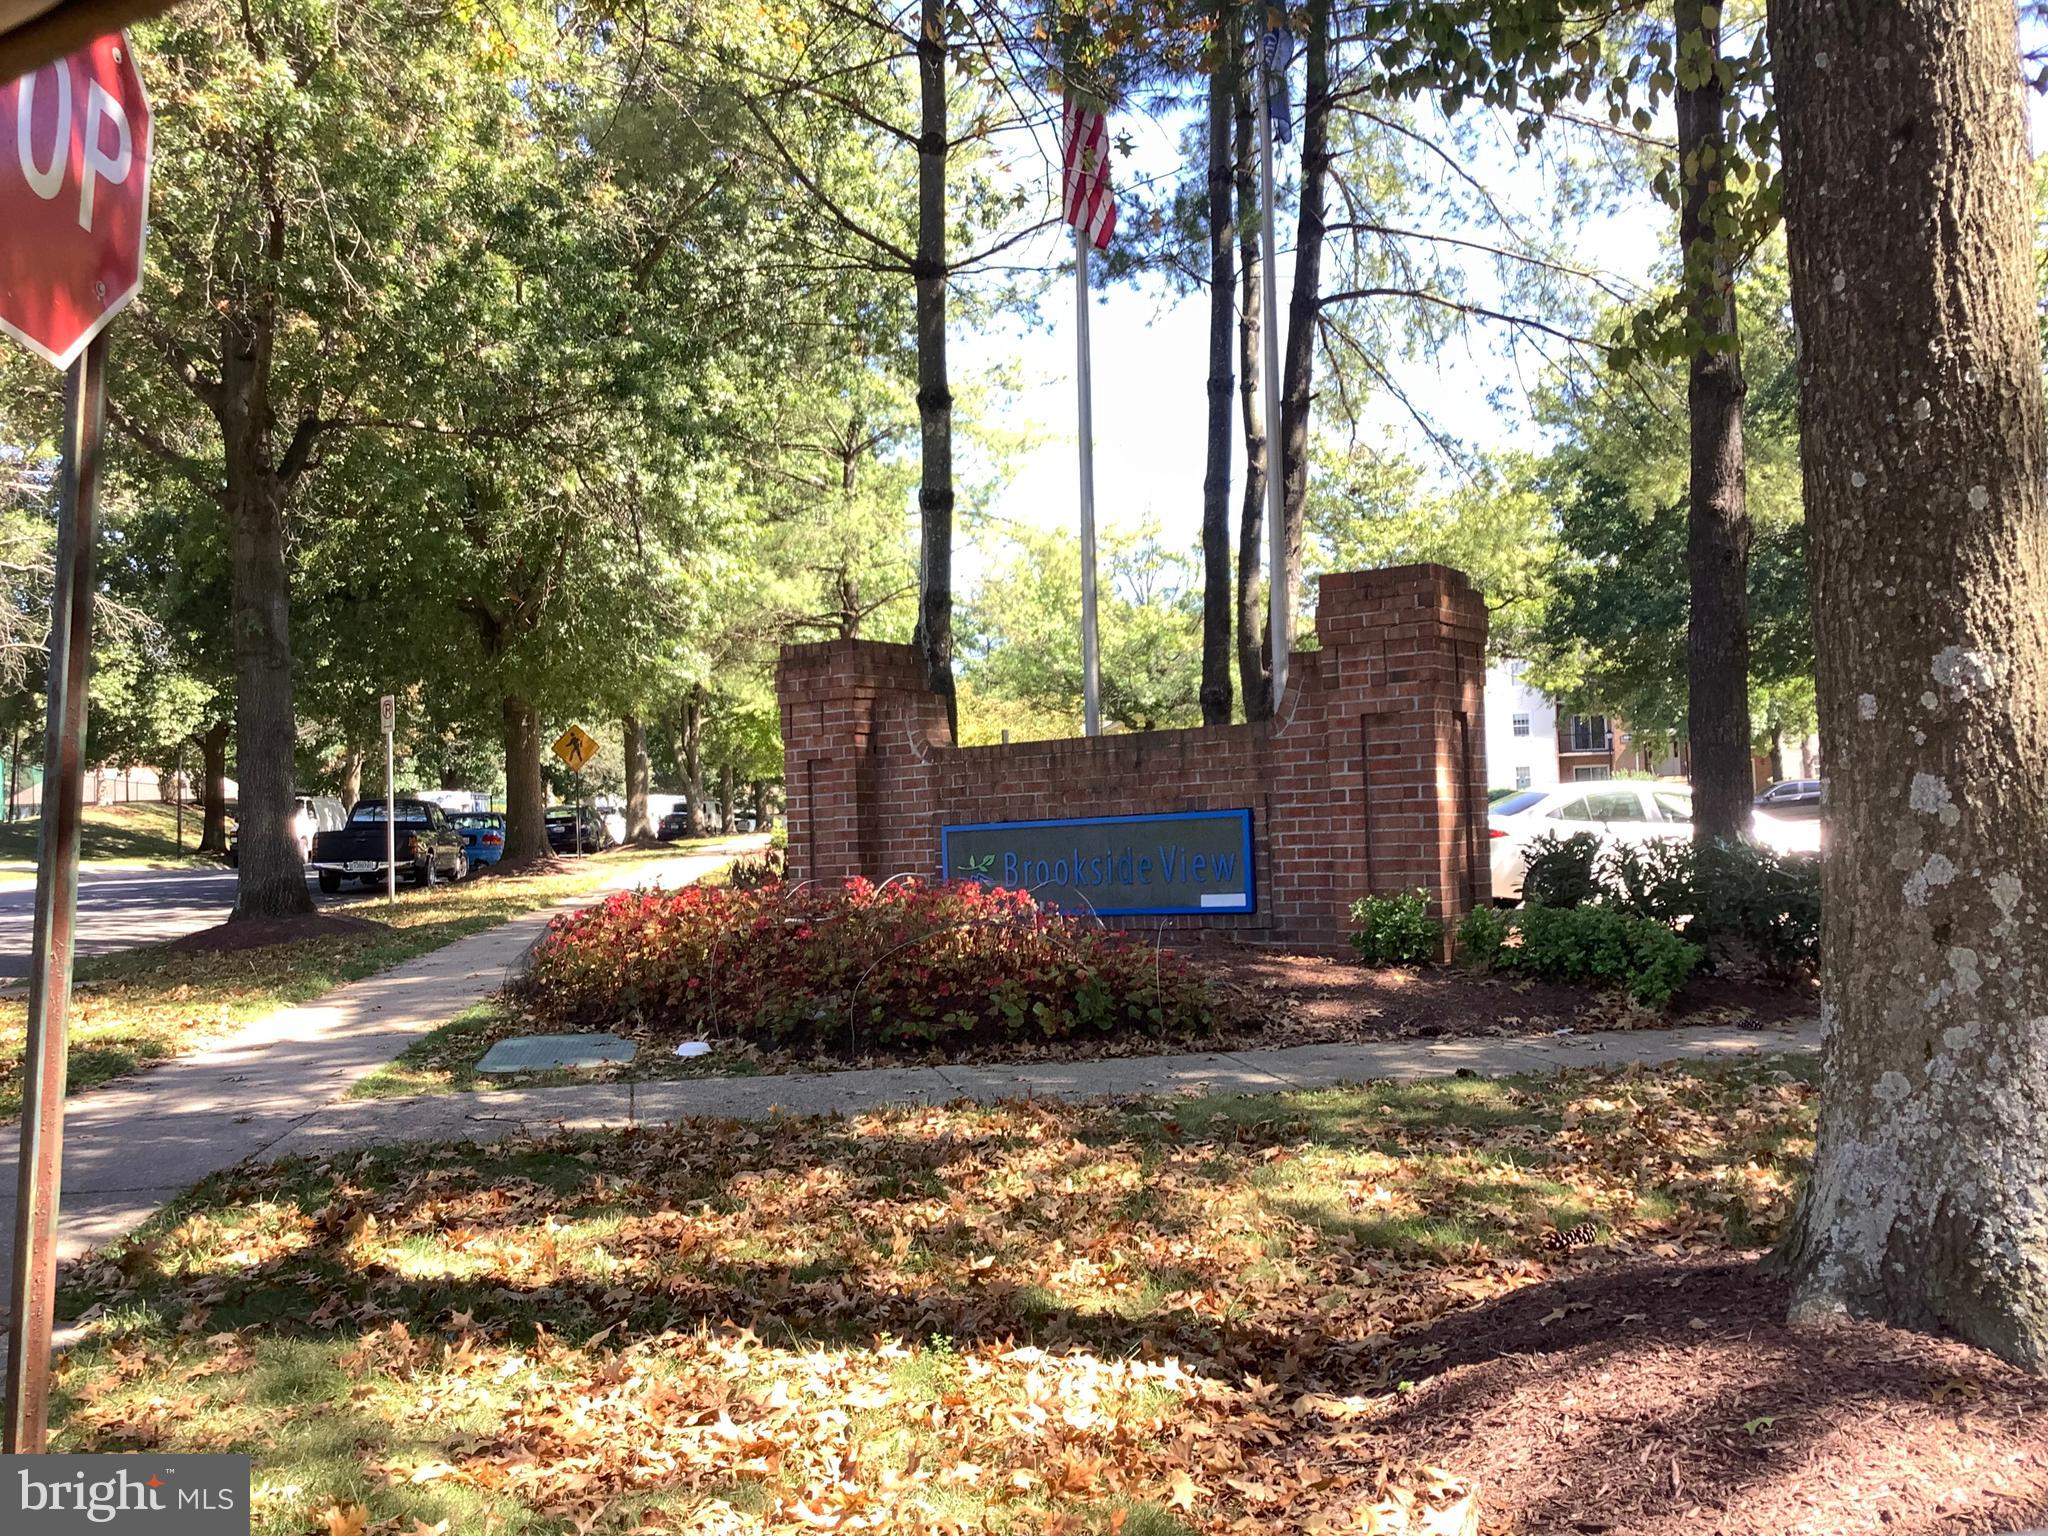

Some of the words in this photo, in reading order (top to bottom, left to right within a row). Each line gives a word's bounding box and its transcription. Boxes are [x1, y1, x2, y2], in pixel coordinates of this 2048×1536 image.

[18, 57, 132, 232] OP
[1004, 847, 1153, 888] Brookside
[1159, 845, 1235, 882] View
